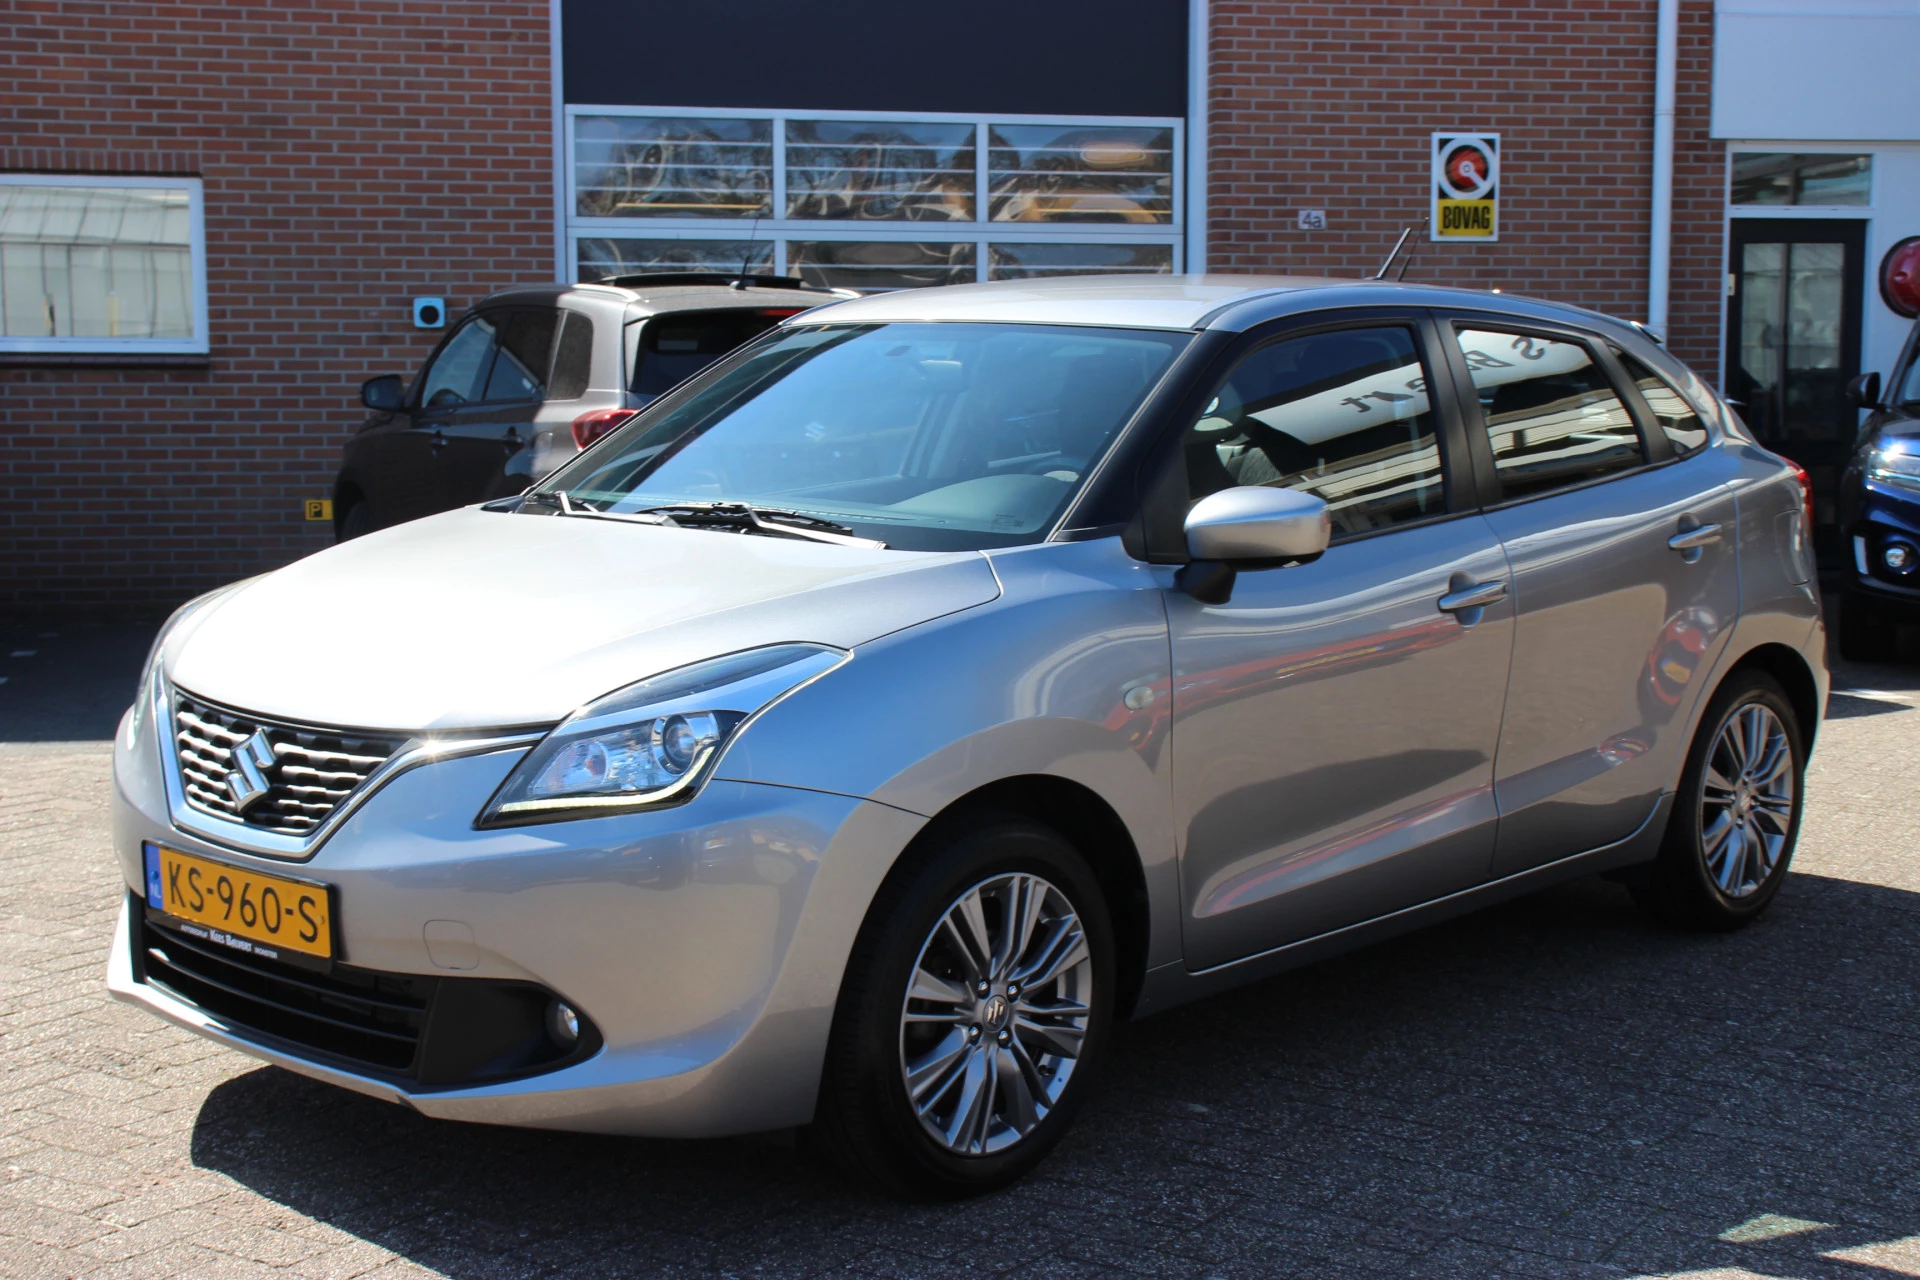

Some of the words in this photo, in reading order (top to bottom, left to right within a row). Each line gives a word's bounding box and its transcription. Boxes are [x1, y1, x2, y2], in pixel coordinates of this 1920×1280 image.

[1302, 211, 1322, 228] 4a
[1443, 206, 1491, 229] BOVAG
[310, 502, 321, 517] P
[150, 882, 162, 899] NL
[168, 861, 318, 943] KS-960-S
